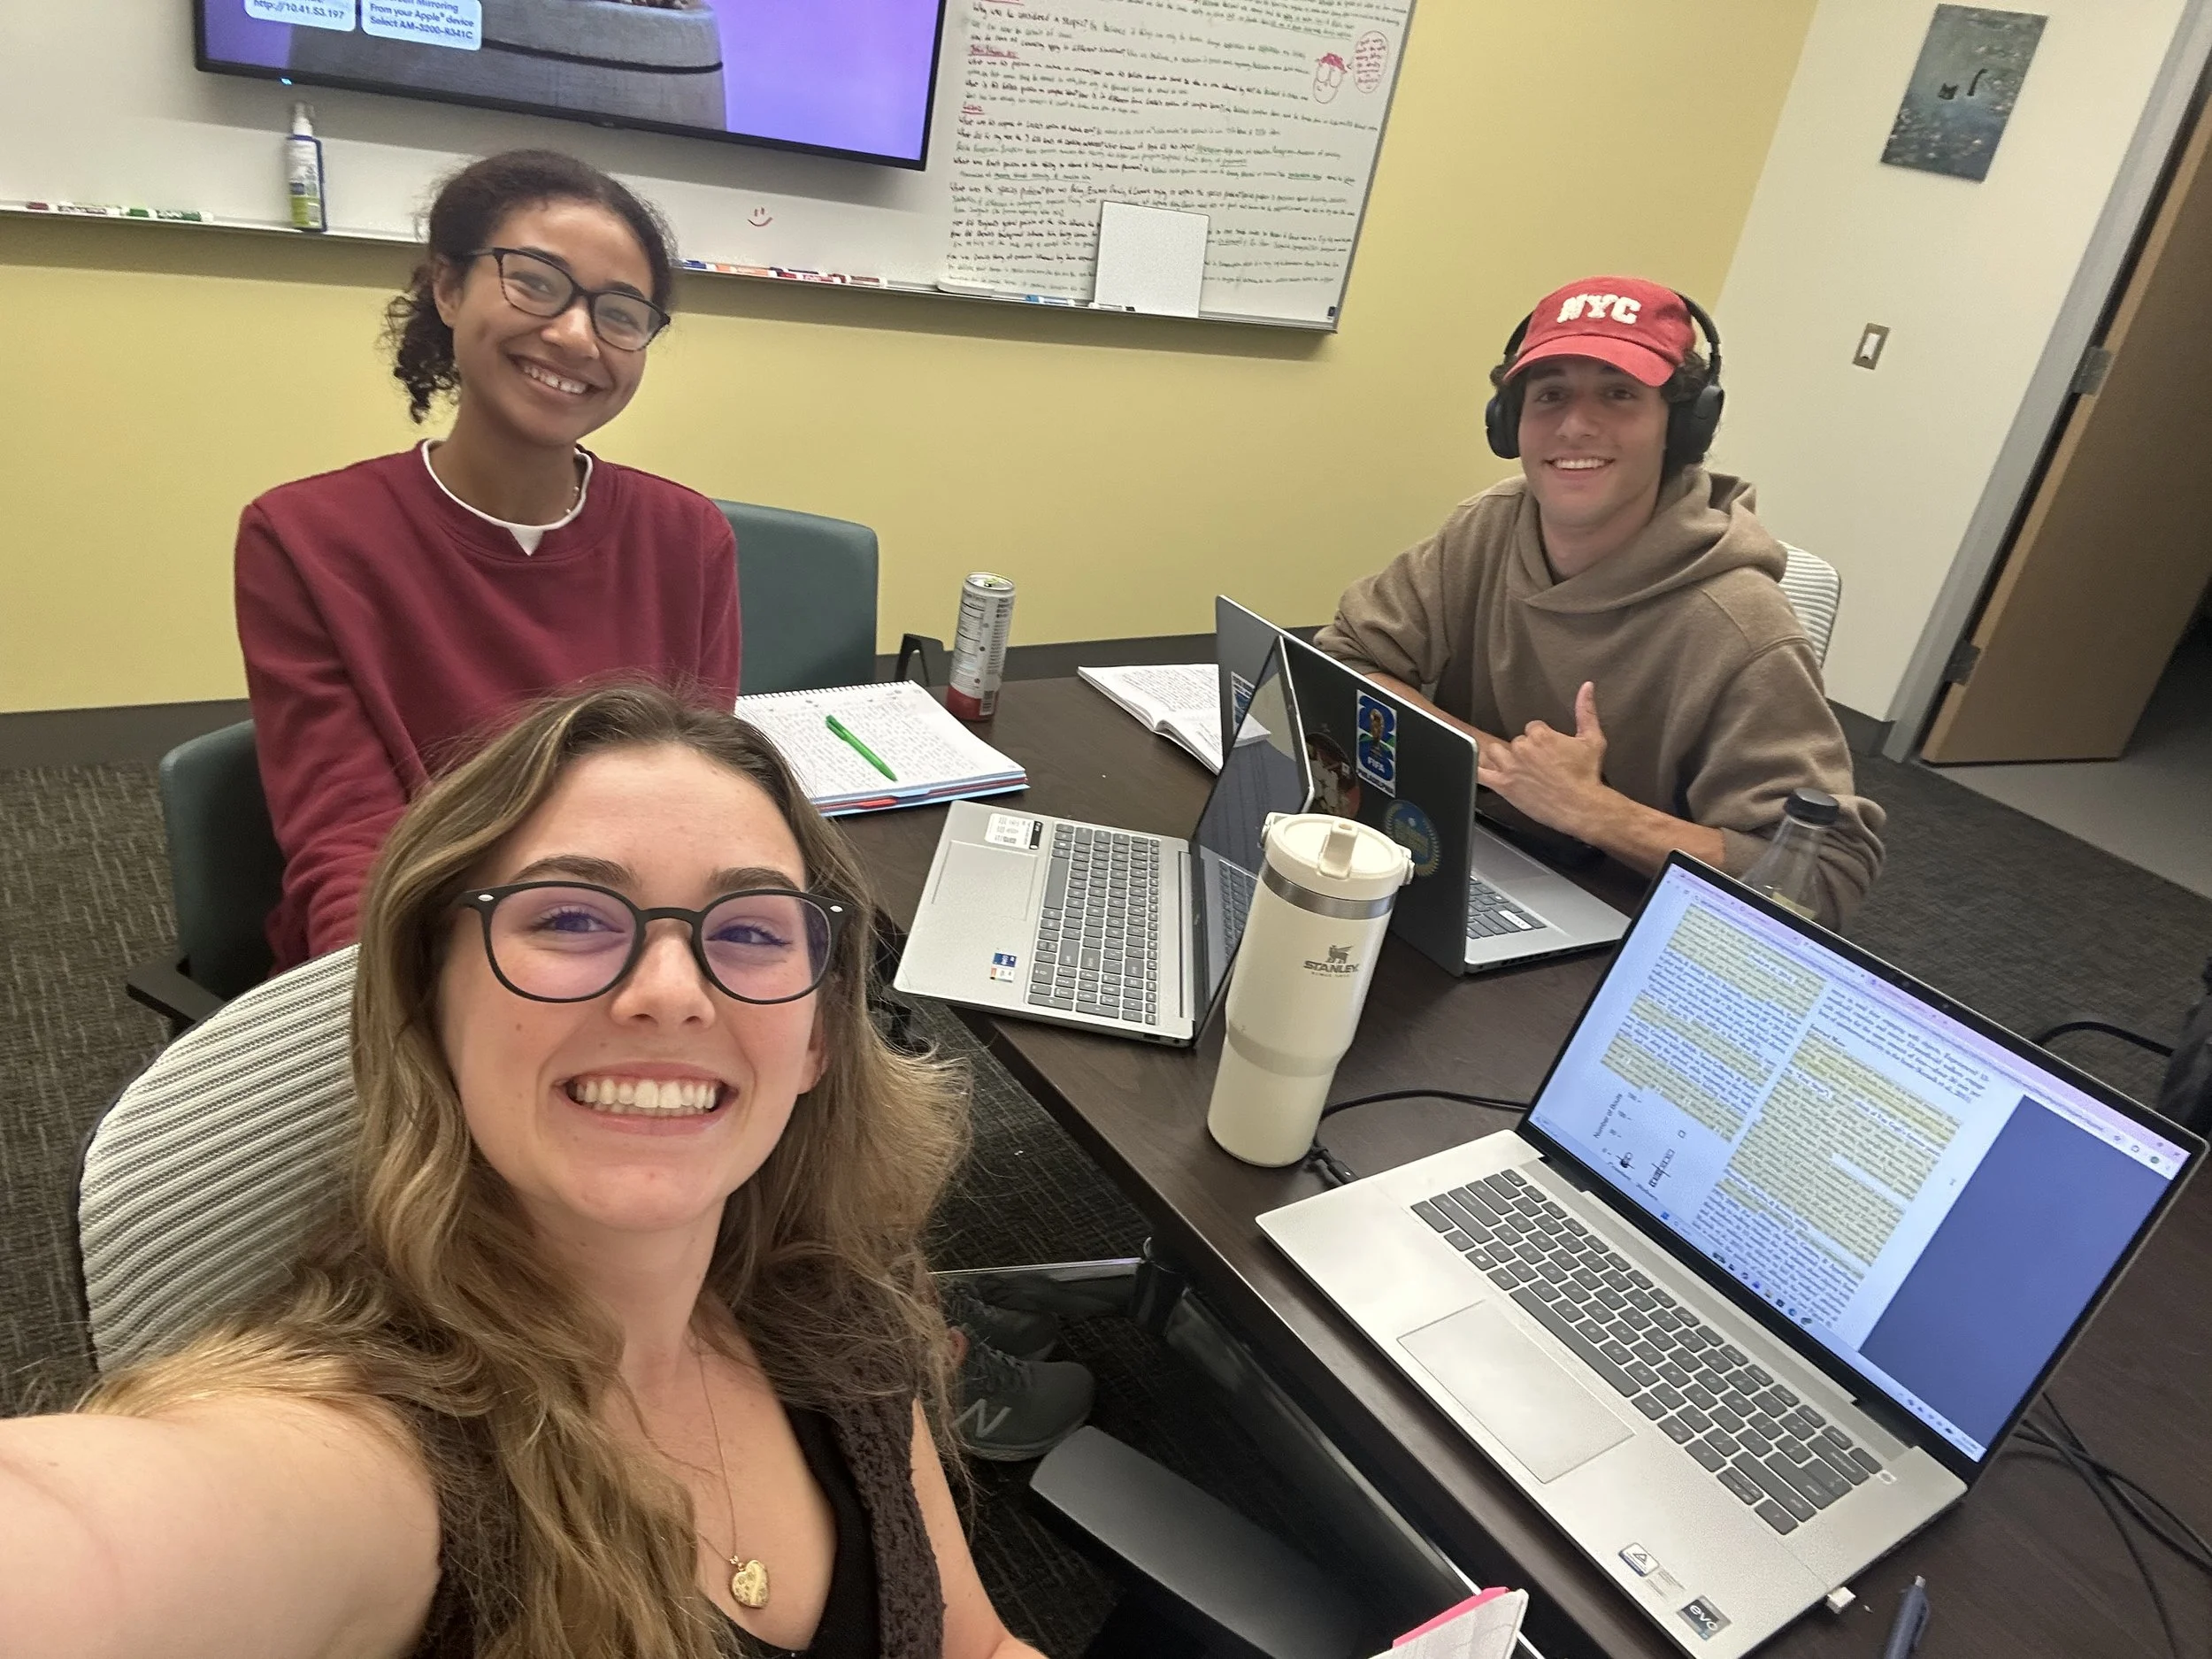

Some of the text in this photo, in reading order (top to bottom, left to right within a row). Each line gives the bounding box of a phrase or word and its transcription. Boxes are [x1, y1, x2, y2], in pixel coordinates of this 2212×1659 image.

[370, 3, 392, 13] From
[394, 8, 412, 17] your
[446, 16, 474, 27] device
[370, 16, 397, 27] Select
[1556, 293, 1642, 325] NYC
[1367, 756, 1386, 774] FIFA
[1303, 960, 1360, 974] STANLEY
[1689, 1604, 1718, 1632] evo
